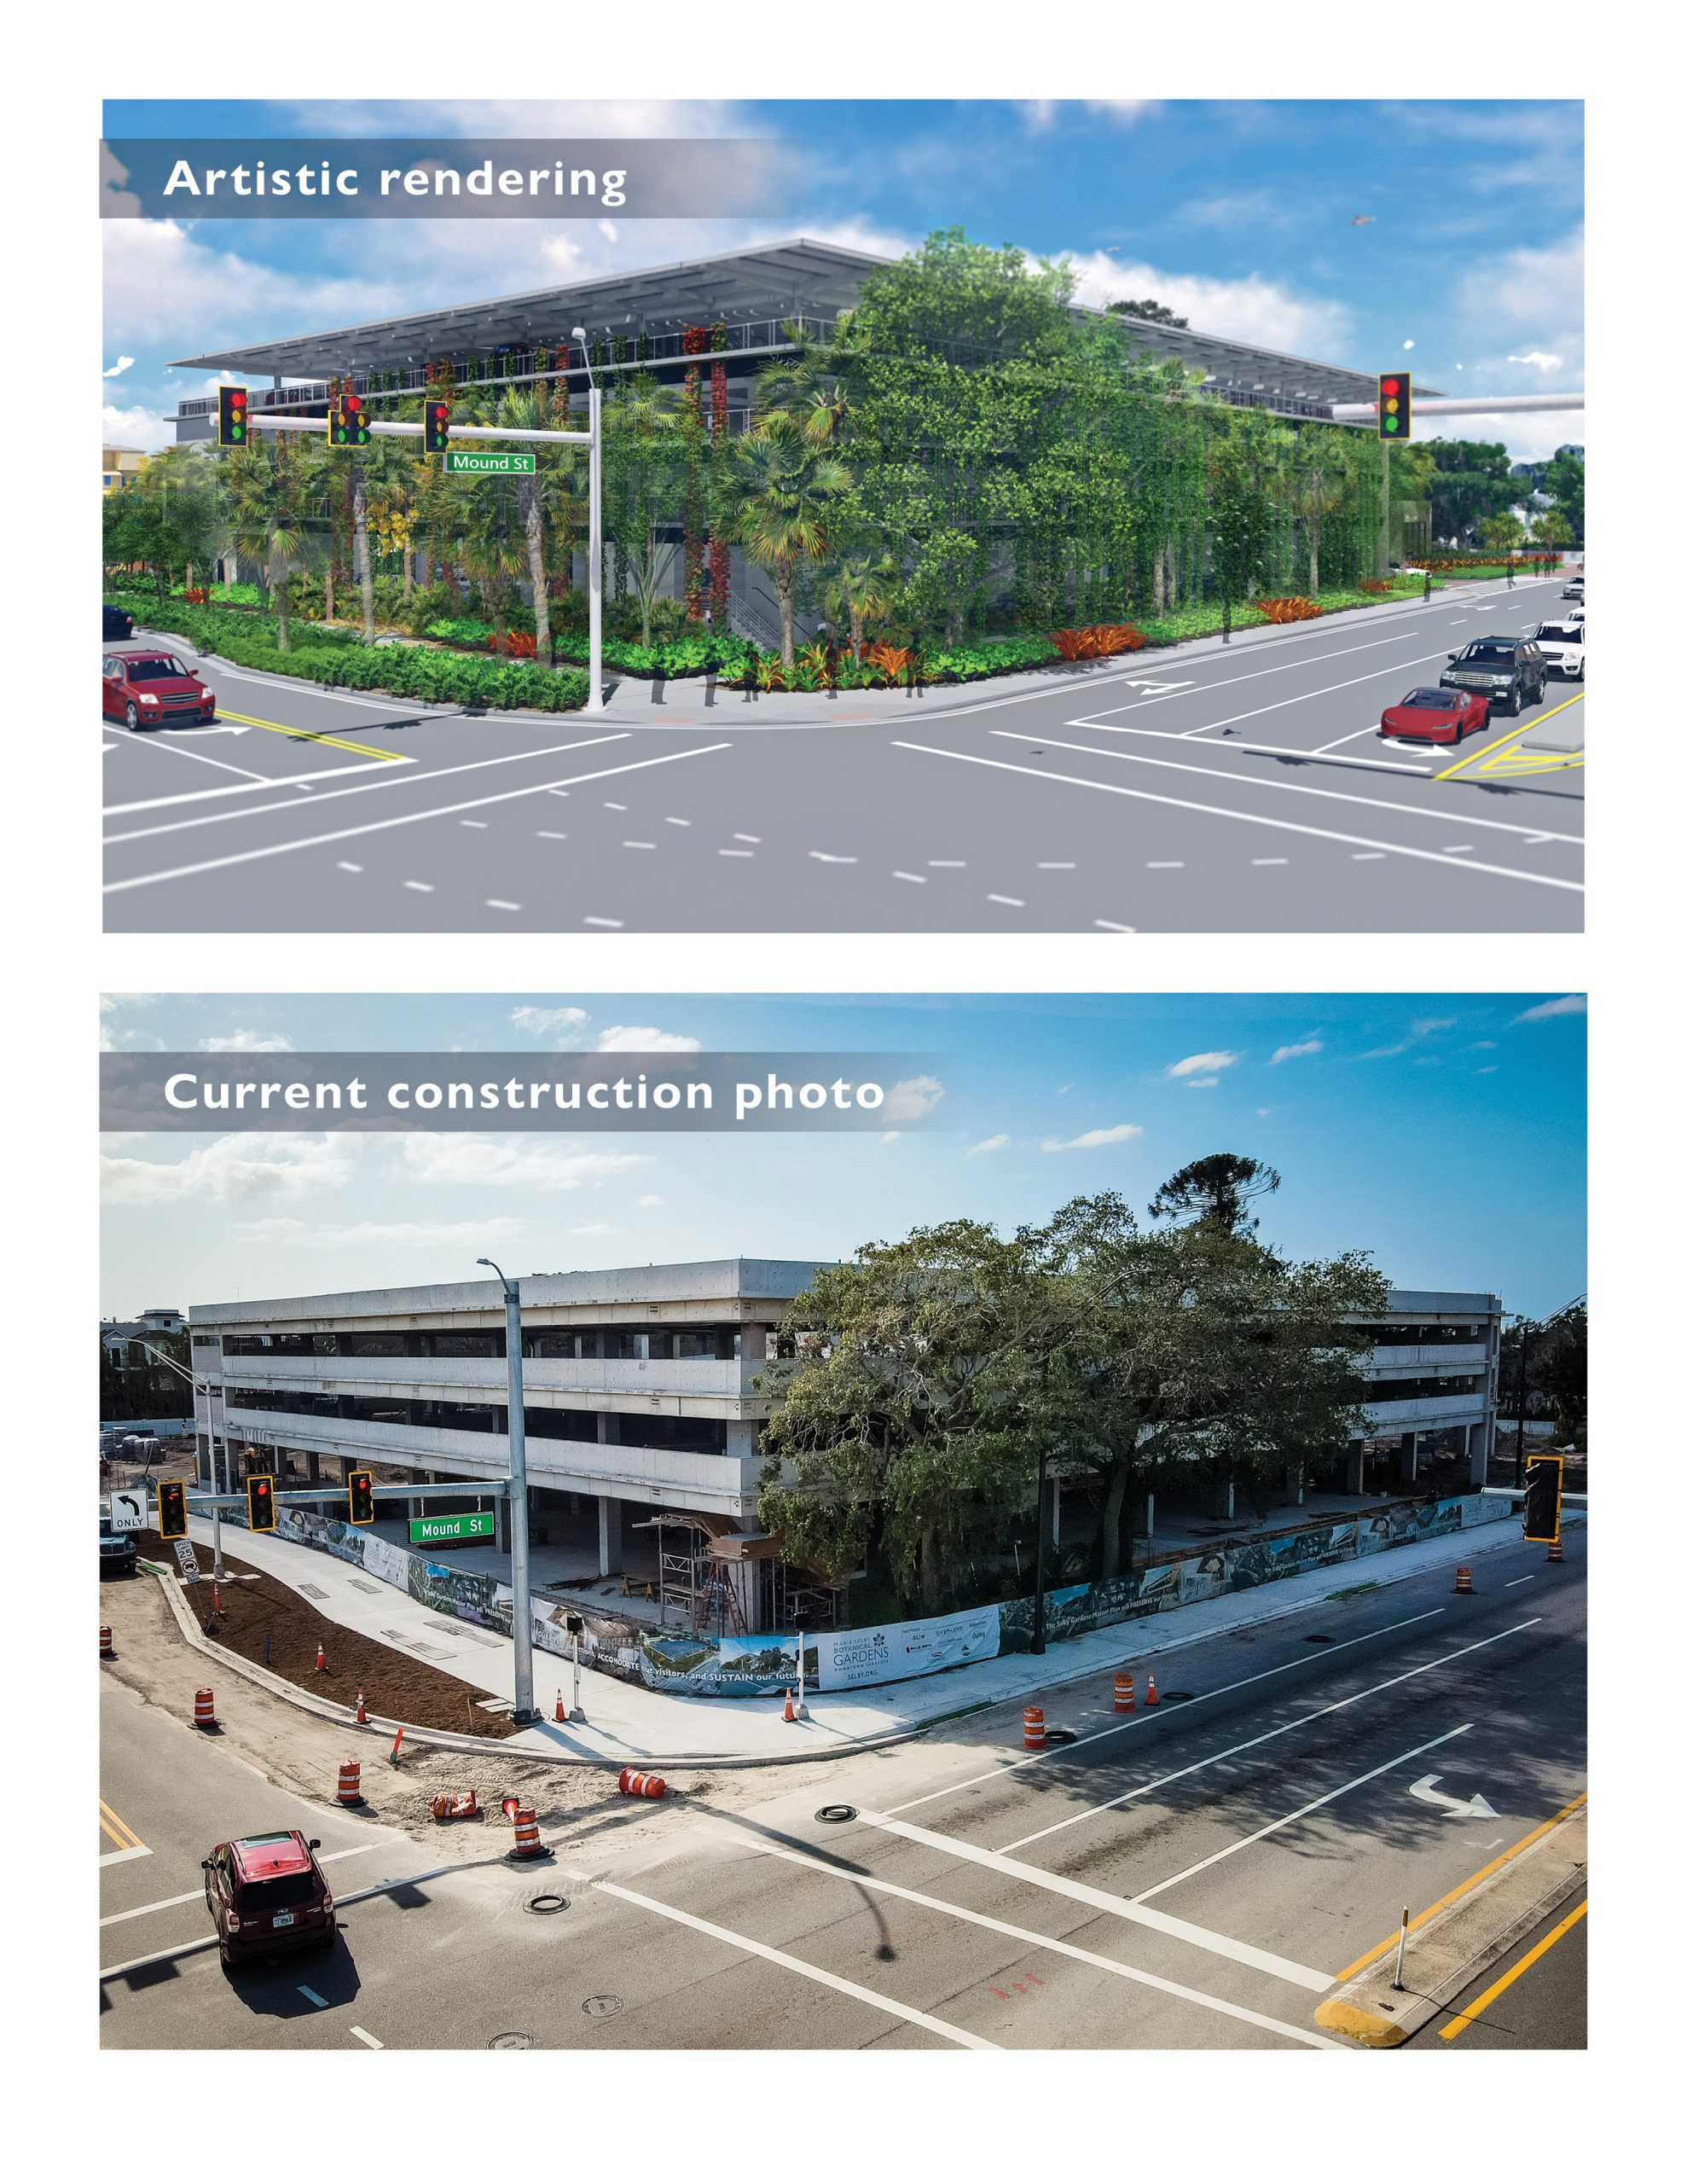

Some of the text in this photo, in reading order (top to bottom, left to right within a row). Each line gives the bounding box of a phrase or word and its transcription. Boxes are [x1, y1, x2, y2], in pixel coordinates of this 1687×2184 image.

[454, 456, 528, 470] Mound St
[117, 1518, 143, 1528] ONLY
[422, 1519, 483, 1537] Mound St
[178, 1548, 193, 1559] 25
[1046, 1622, 1056, 1630] The
[1070, 1612, 1092, 1623] Gardens
[1110, 1606, 1121, 1614] Plan
[1130, 1596, 1153, 1608] PRESERVE
[833, 1643, 872, 1653] BOTANICAL
[566, 1643, 596, 1658] colctions,
[597, 1654, 640, 1670] ACCOMODATE
[655, 1668, 688, 1679] visitors,
[690, 1670, 707, 1680] and
[708, 1673, 753, 1682] SUSTAIN
[833, 1647, 890, 1666] GARDENS
[847, 1670, 878, 1681] SELBY.ORG
